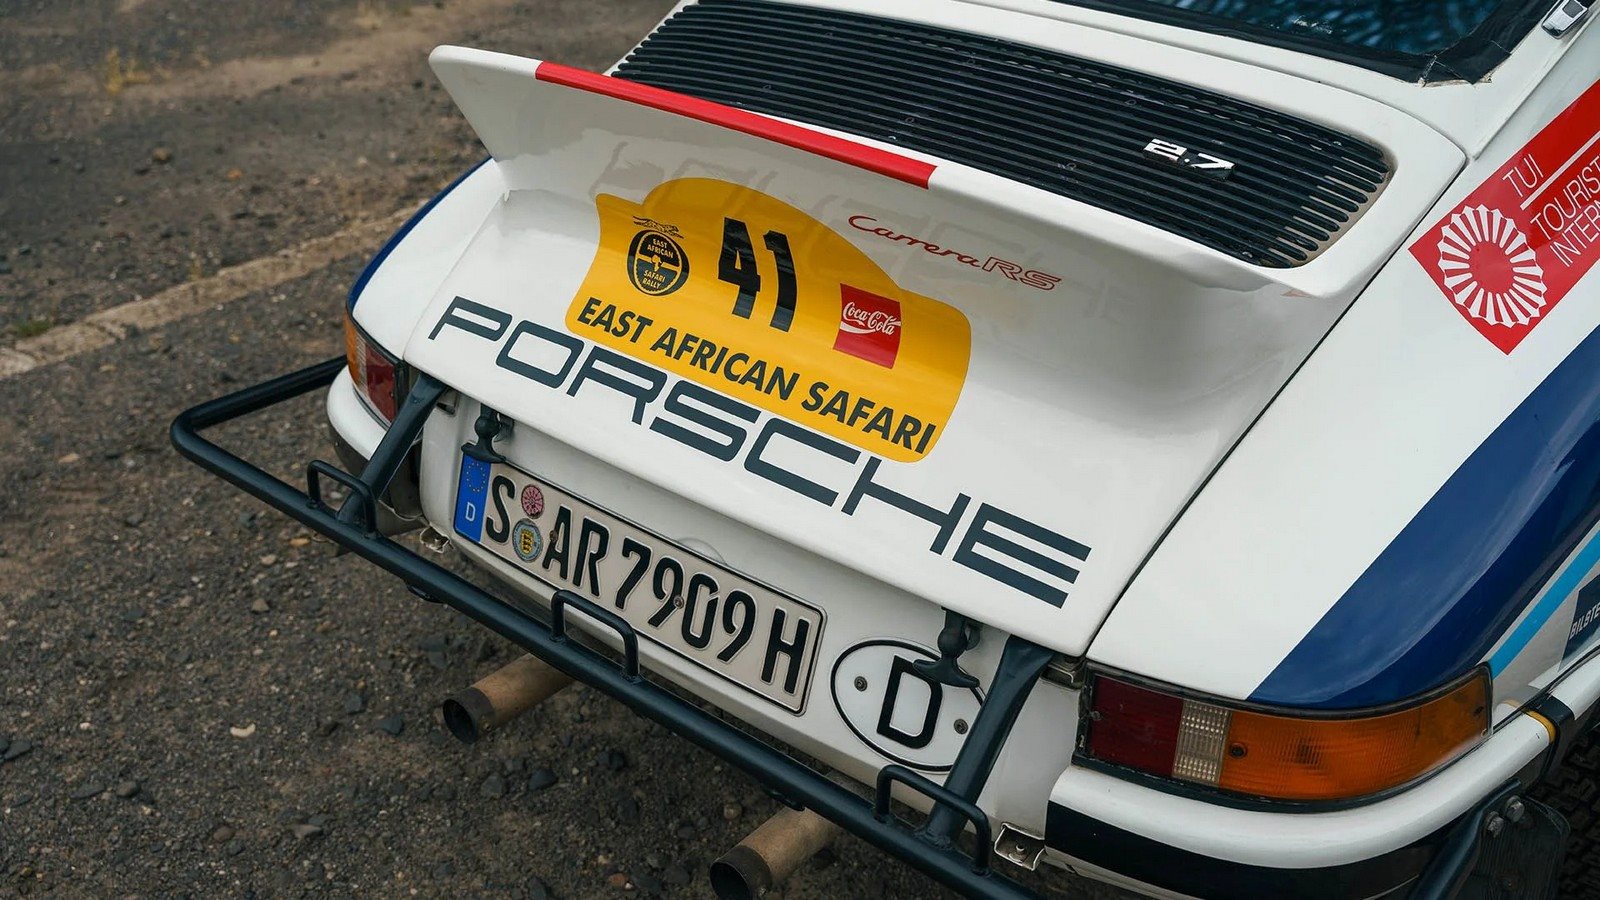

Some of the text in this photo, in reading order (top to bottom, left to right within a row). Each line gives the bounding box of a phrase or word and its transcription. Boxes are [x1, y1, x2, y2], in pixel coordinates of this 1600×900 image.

[1144, 138, 1236, 180] 2.7
[1503, 154, 1543, 198] TUI
[647, 244, 674, 258] AFRICAN
[652, 238, 668, 249] EAST
[848, 215, 1063, 291] Carrera RS
[1550, 199, 1600, 267] INTER
[642, 277, 661, 289] RALLY
[643, 269, 666, 282] SAFARI
[717, 217, 797, 333] 41
[843, 301, 899, 335] Coca-Cola
[577, 297, 936, 454] EAST AFRICAN SAFARI
[428, 296, 1092, 609] PORSCHE
[465, 502, 476, 521] D
[543, 506, 609, 596] AR
[877, 655, 942, 748] D
